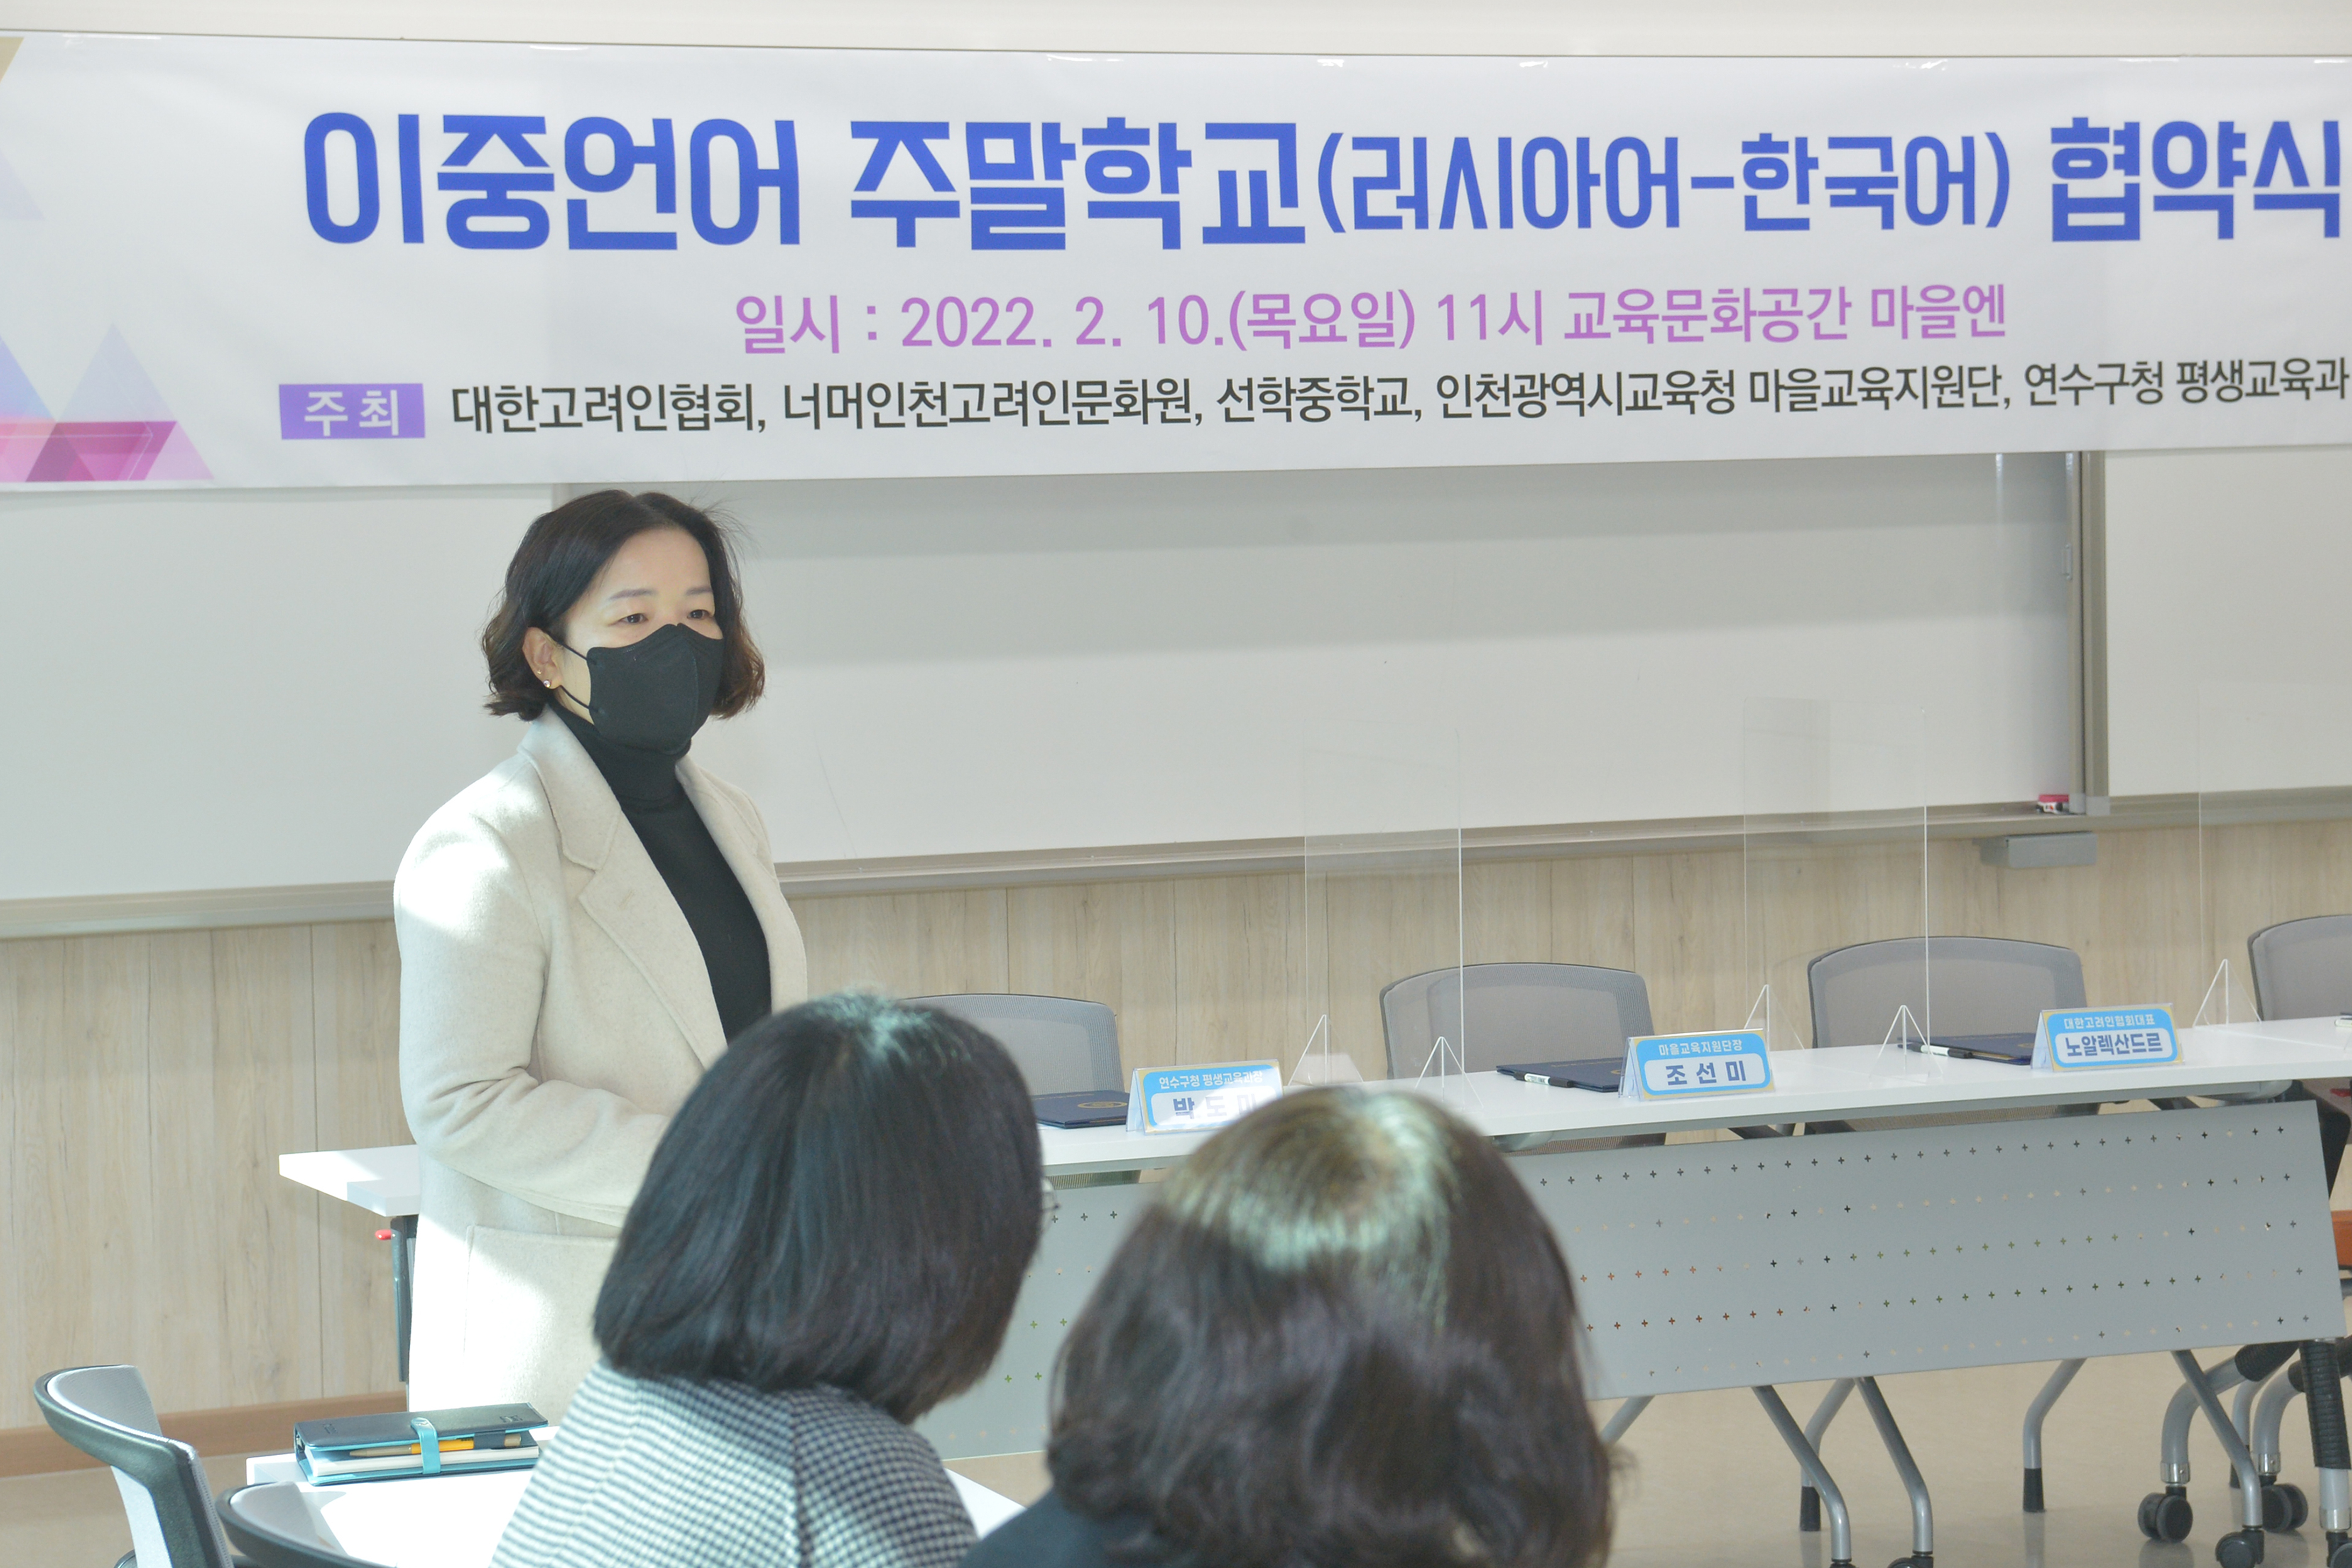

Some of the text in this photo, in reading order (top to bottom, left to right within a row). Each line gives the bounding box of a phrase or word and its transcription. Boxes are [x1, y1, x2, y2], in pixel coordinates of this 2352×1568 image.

[304, 112, 2341, 250] 이중언어 주말학교(러시아어-한국어) 협약식
[736, 284, 2005, 354] 일시 : 2022. 2. 10.(목요일) 11시 교육문화공간 마을엔
[452, 383, 766, 434] 대한고려인협회,
[784, 378, 1203, 430] 너머인천고려인문화원,
[1217, 374, 1422, 423] 선학중학교,
[1436, 369, 1735, 419] 인천광역시교육청
[1749, 364, 2010, 413] 마을교육지원단,
[2024, 361, 2163, 406] 연수구청
[2176, 357, 2350, 404] 평생교육과
[2063, 1014, 2155, 1030] 대한고려인협회대표
[1658, 1039, 1743, 1056] 마을교육지원단장
[2065, 1033, 2163, 1057] 노알렉산드르
[1159, 1070, 1263, 1089] 연수구청 평생교육과장
